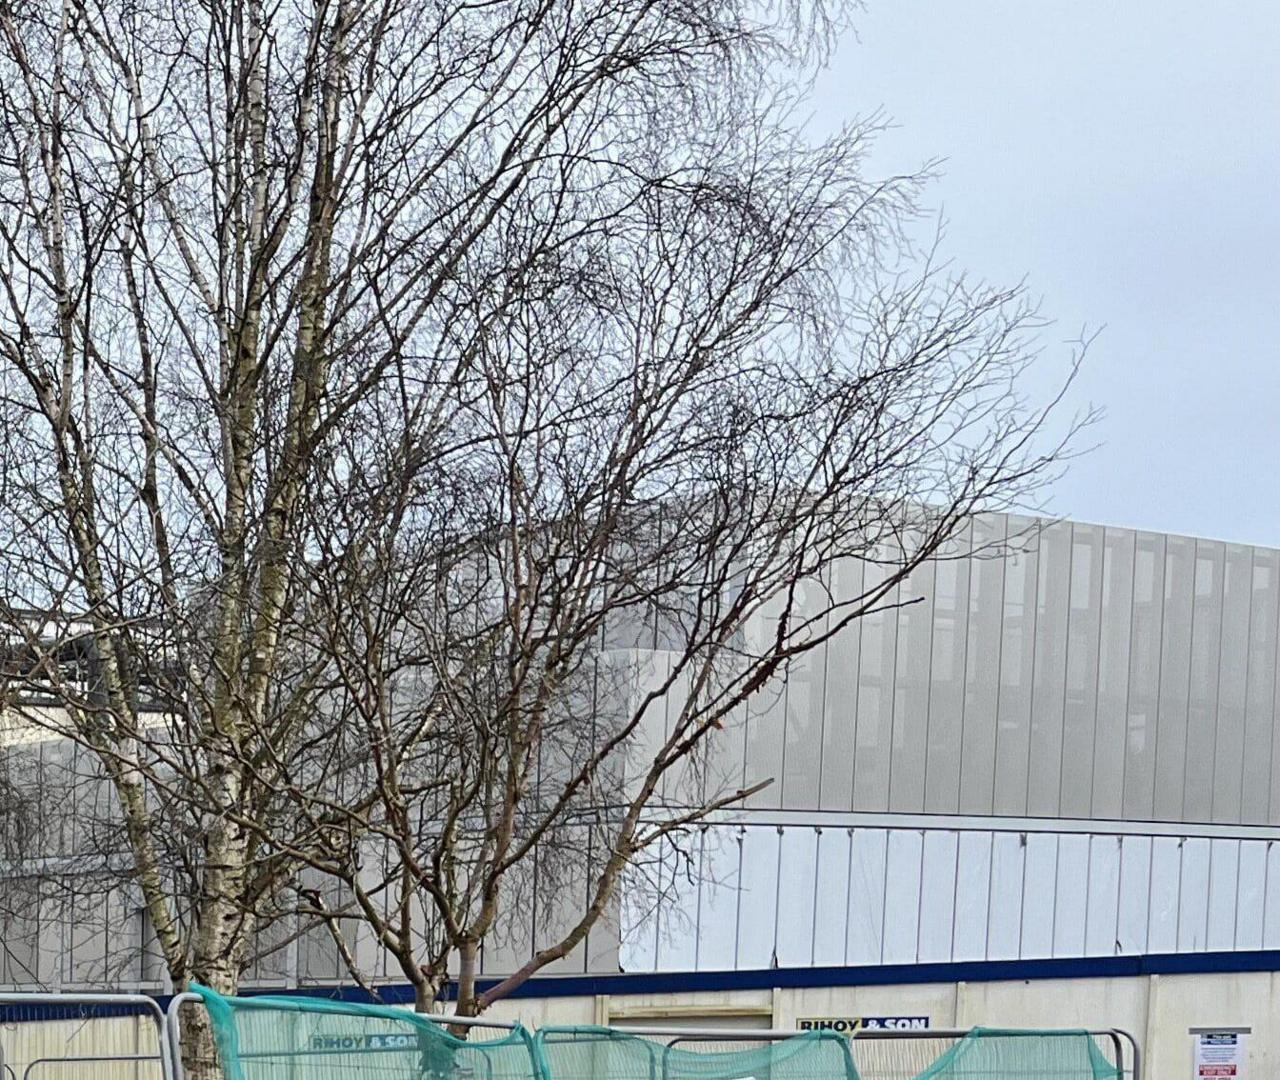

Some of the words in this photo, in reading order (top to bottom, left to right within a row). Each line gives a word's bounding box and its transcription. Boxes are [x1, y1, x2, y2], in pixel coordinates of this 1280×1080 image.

[800, 1020, 859, 1031] RIHOY
[867, 1019, 880, 1029] &
[884, 1018, 925, 1029] SON
[313, 1037, 363, 1049] RIHOY
[369, 1036, 381, 1048] &
[384, 1035, 419, 1048] SON
